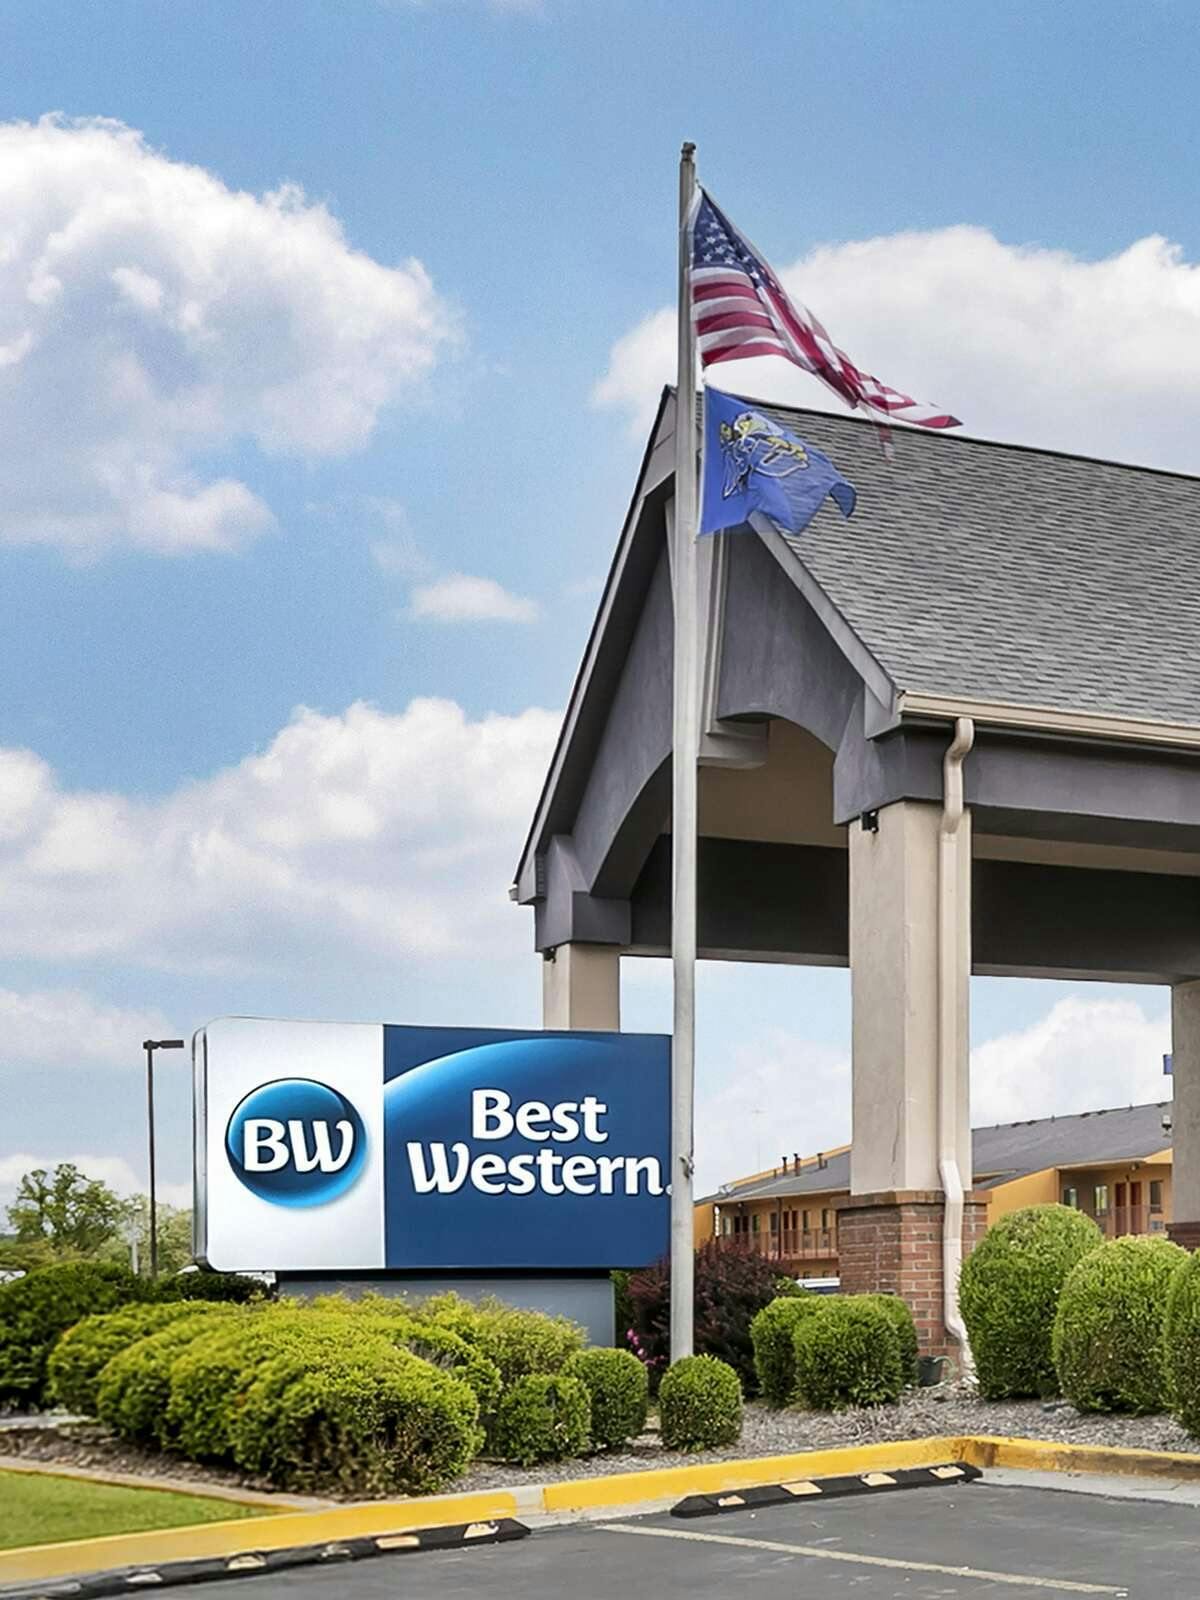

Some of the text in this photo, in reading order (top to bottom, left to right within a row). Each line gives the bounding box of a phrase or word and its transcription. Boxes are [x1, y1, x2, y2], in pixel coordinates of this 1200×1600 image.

[472, 1089, 608, 1142] Best
[244, 1119, 354, 1172] BW
[406, 1142, 664, 1195] Western
